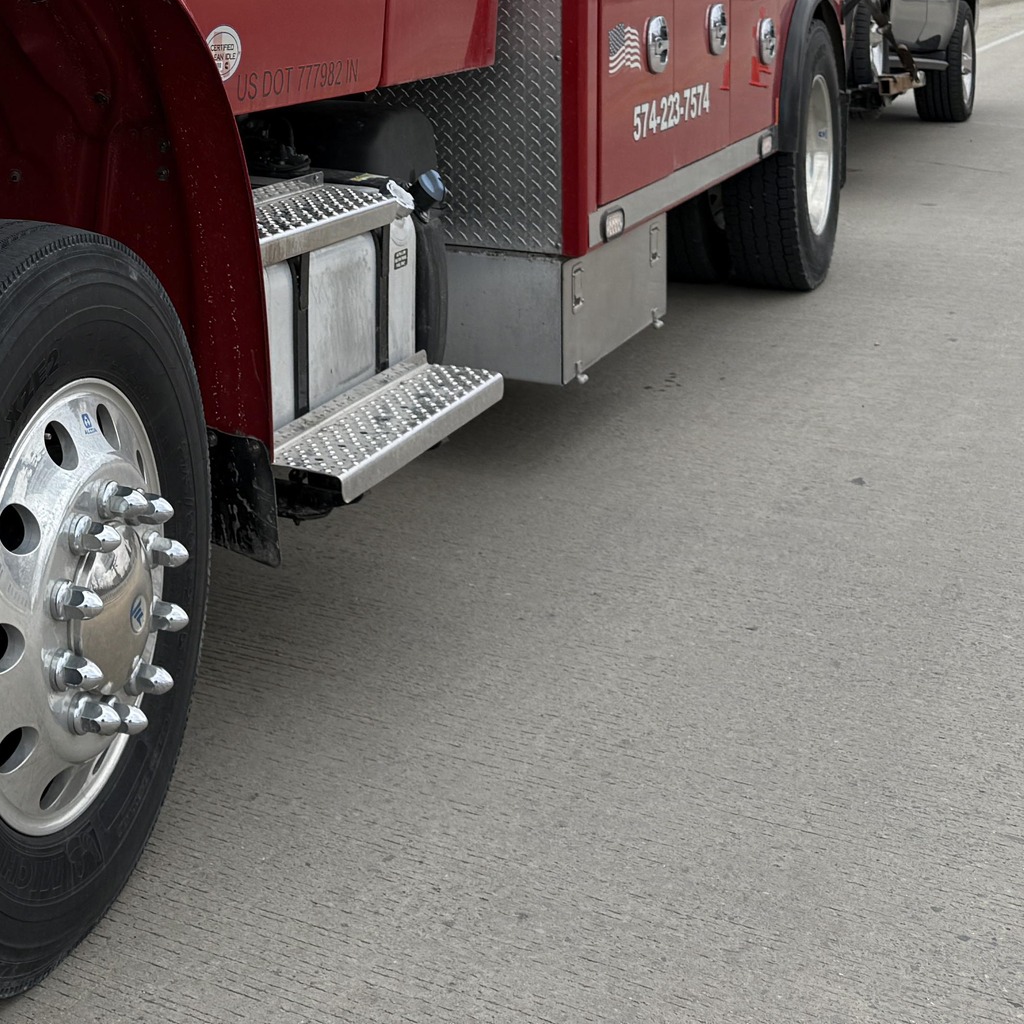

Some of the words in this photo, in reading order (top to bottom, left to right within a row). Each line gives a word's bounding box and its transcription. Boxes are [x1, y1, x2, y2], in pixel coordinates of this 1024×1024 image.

[237, 72, 258, 101] US
[263, 67, 293, 97] DOT
[298, 60, 342, 92] 777982
[346, 58, 359, 83] IN
[633, 82, 710, 142] 574-223-7574
